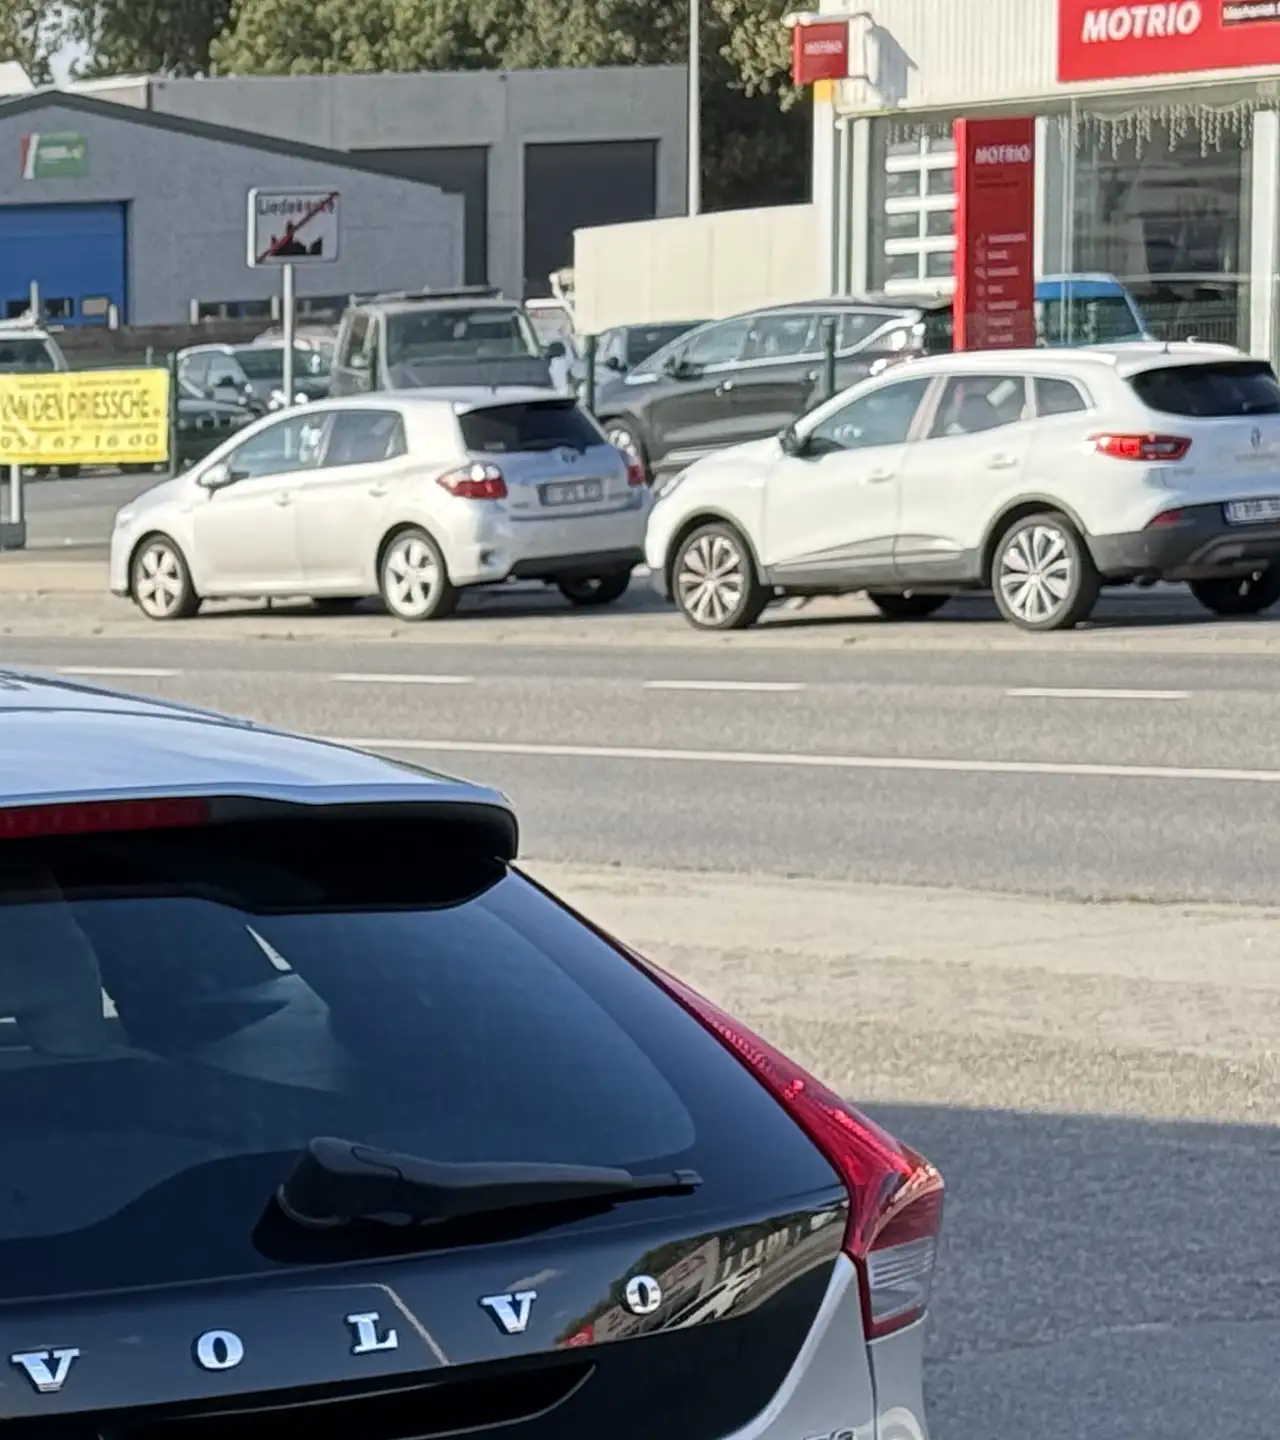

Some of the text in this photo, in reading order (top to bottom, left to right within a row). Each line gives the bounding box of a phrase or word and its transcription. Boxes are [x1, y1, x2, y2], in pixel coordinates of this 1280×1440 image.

[1081, 2, 1202, 44] MOTRIO
[974, 144, 1032, 165] MOTRIO
[32, 393, 65, 421] DEN
[11, 1273, 663, 1392] VOLVO
